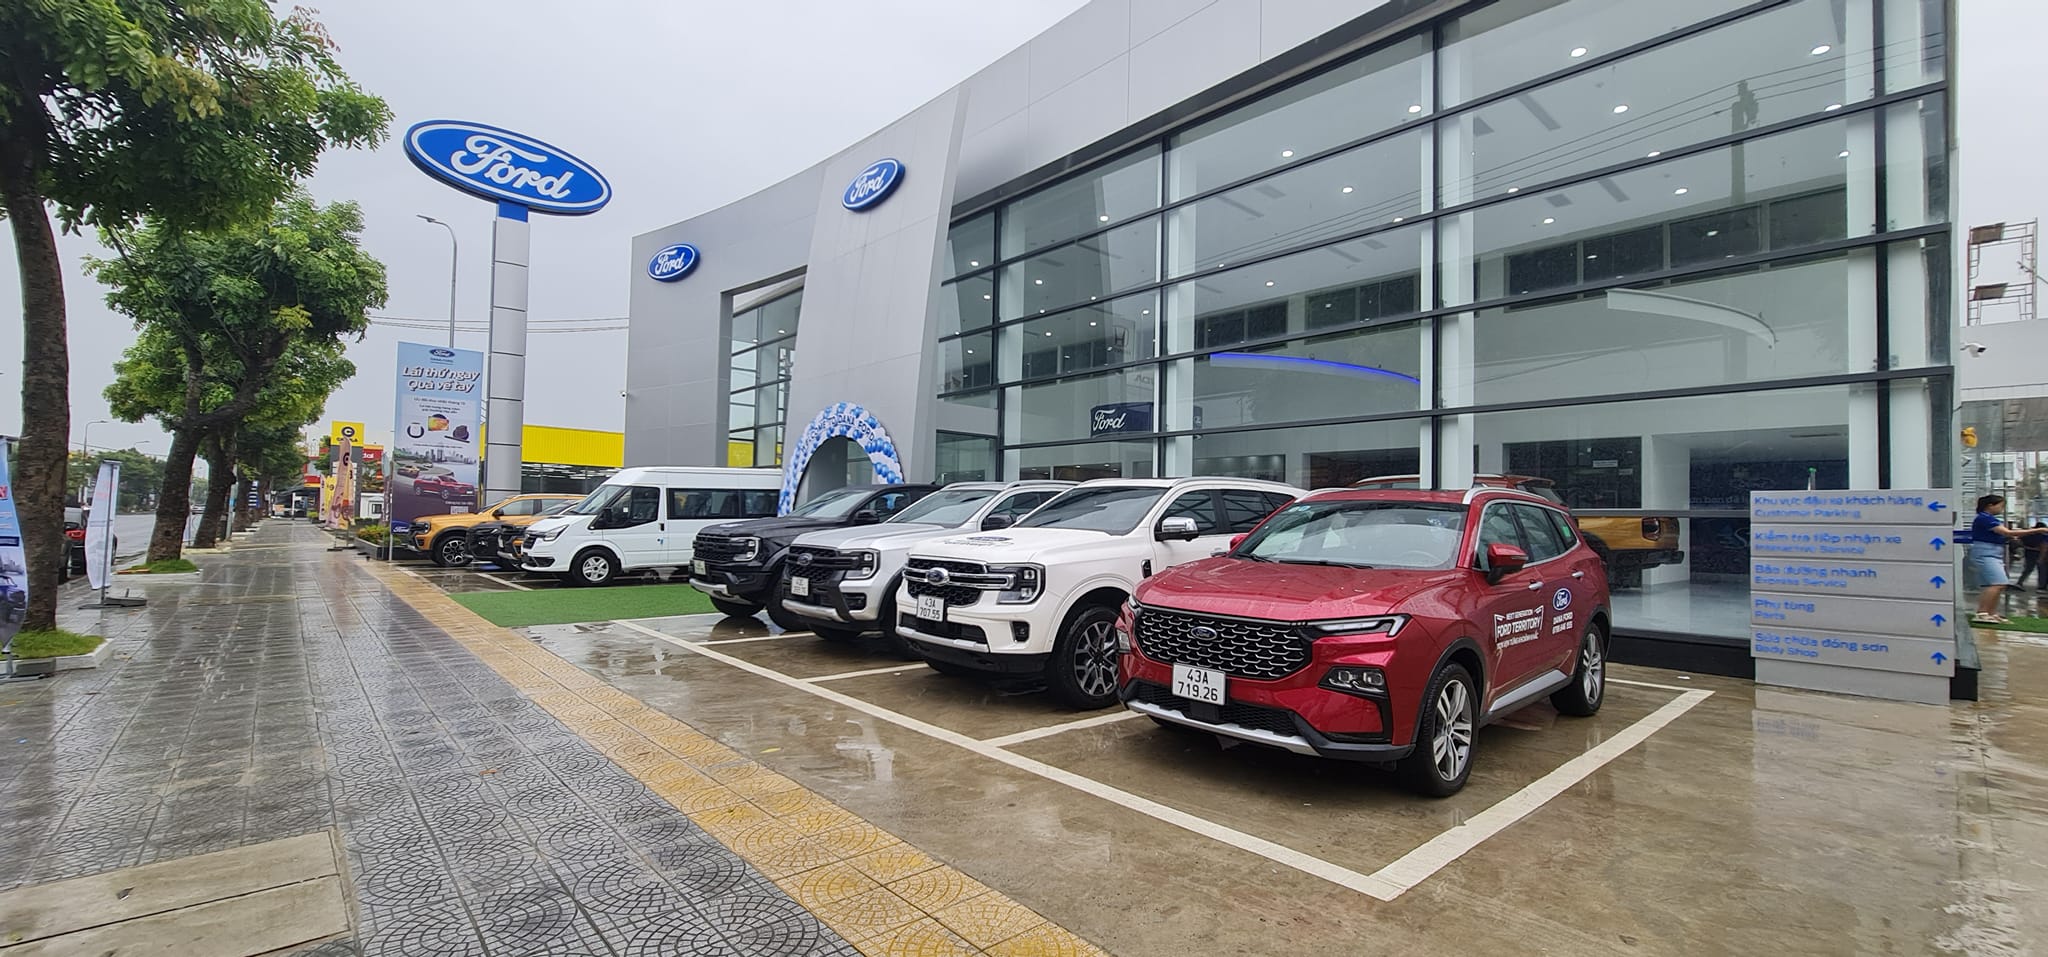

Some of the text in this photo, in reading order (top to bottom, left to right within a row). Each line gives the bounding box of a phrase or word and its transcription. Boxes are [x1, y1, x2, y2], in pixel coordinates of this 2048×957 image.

[450, 134, 570, 198] Ford
[848, 163, 886, 200] Ford
[654, 249, 685, 274] Ford
[449, 371, 480, 381] ngay
[454, 381, 475, 393] tay
[1092, 408, 1127, 431] Ford
[857, 420, 875, 441] FORD
[1754, 495, 1778, 505] Khu
[1844, 495, 1886, 505] khách
[1754, 508, 1862, 519] Customer Parking
[1884, 536, 1902, 544] xe
[1819, 544, 1865, 554] Service
[1831, 568, 1877, 578] nhanh
[1754, 576, 1848, 588] Express Service
[924, 597, 936, 608] 43A
[919, 606, 940, 620] 707.55
[1563, 611, 1573, 620] FORD
[1755, 610, 1786, 620] Parts
[1498, 623, 1512, 637] FORD
[1512, 616, 1541, 634] TERRITORY
[1755, 644, 1819, 658] Body Shop
[1187, 669, 1209, 685] 43A
[1178, 681, 1218, 701] 719.26
